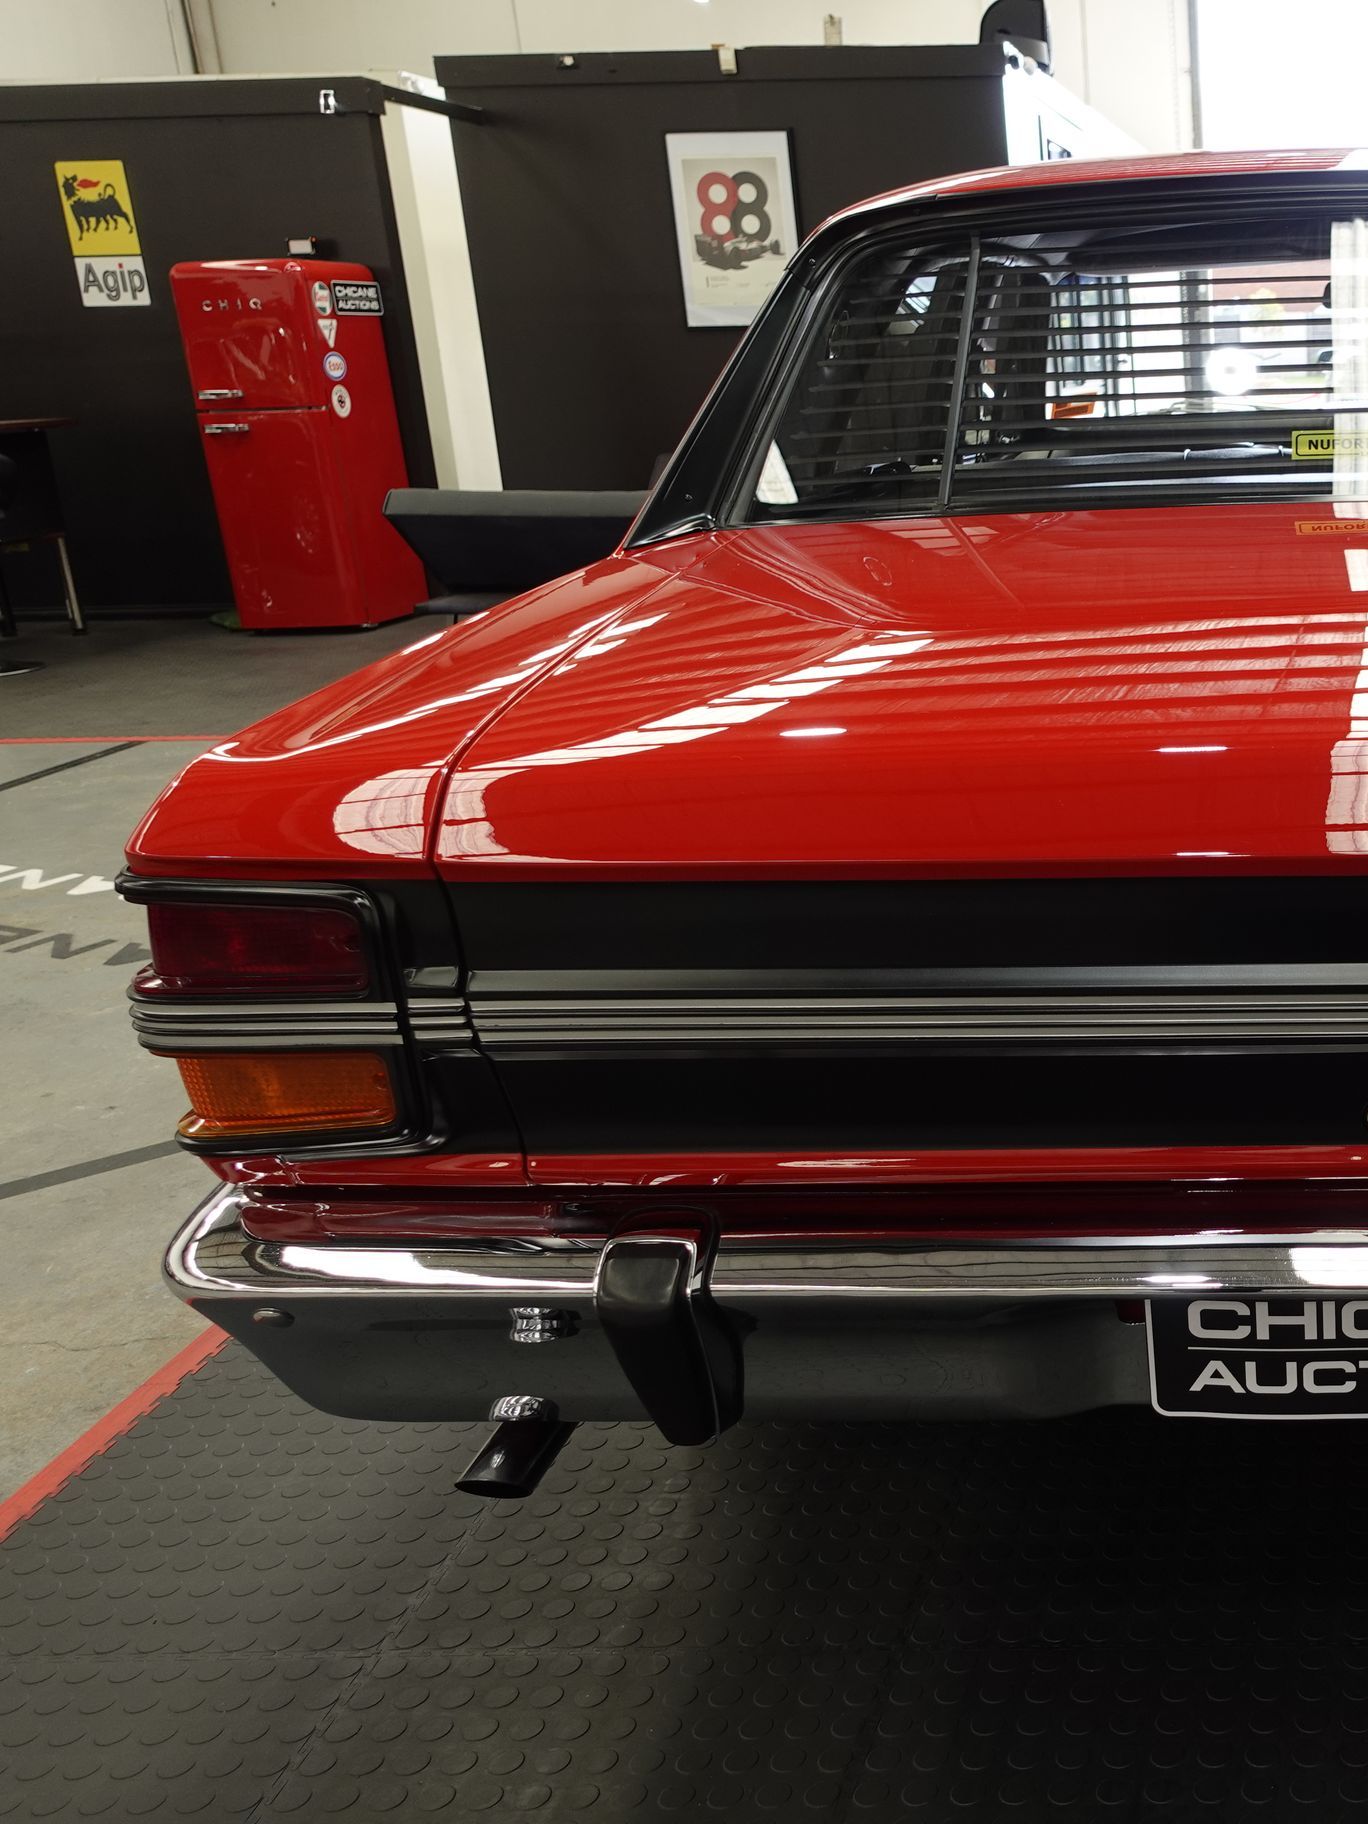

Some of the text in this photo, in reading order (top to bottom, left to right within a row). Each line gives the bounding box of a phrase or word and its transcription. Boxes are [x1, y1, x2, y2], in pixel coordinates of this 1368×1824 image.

[83, 262, 145, 301] Agip
[334, 285, 377, 299] CHICANE
[202, 297, 263, 312] CHIQ
[337, 299, 380, 311] AUCTIONS
